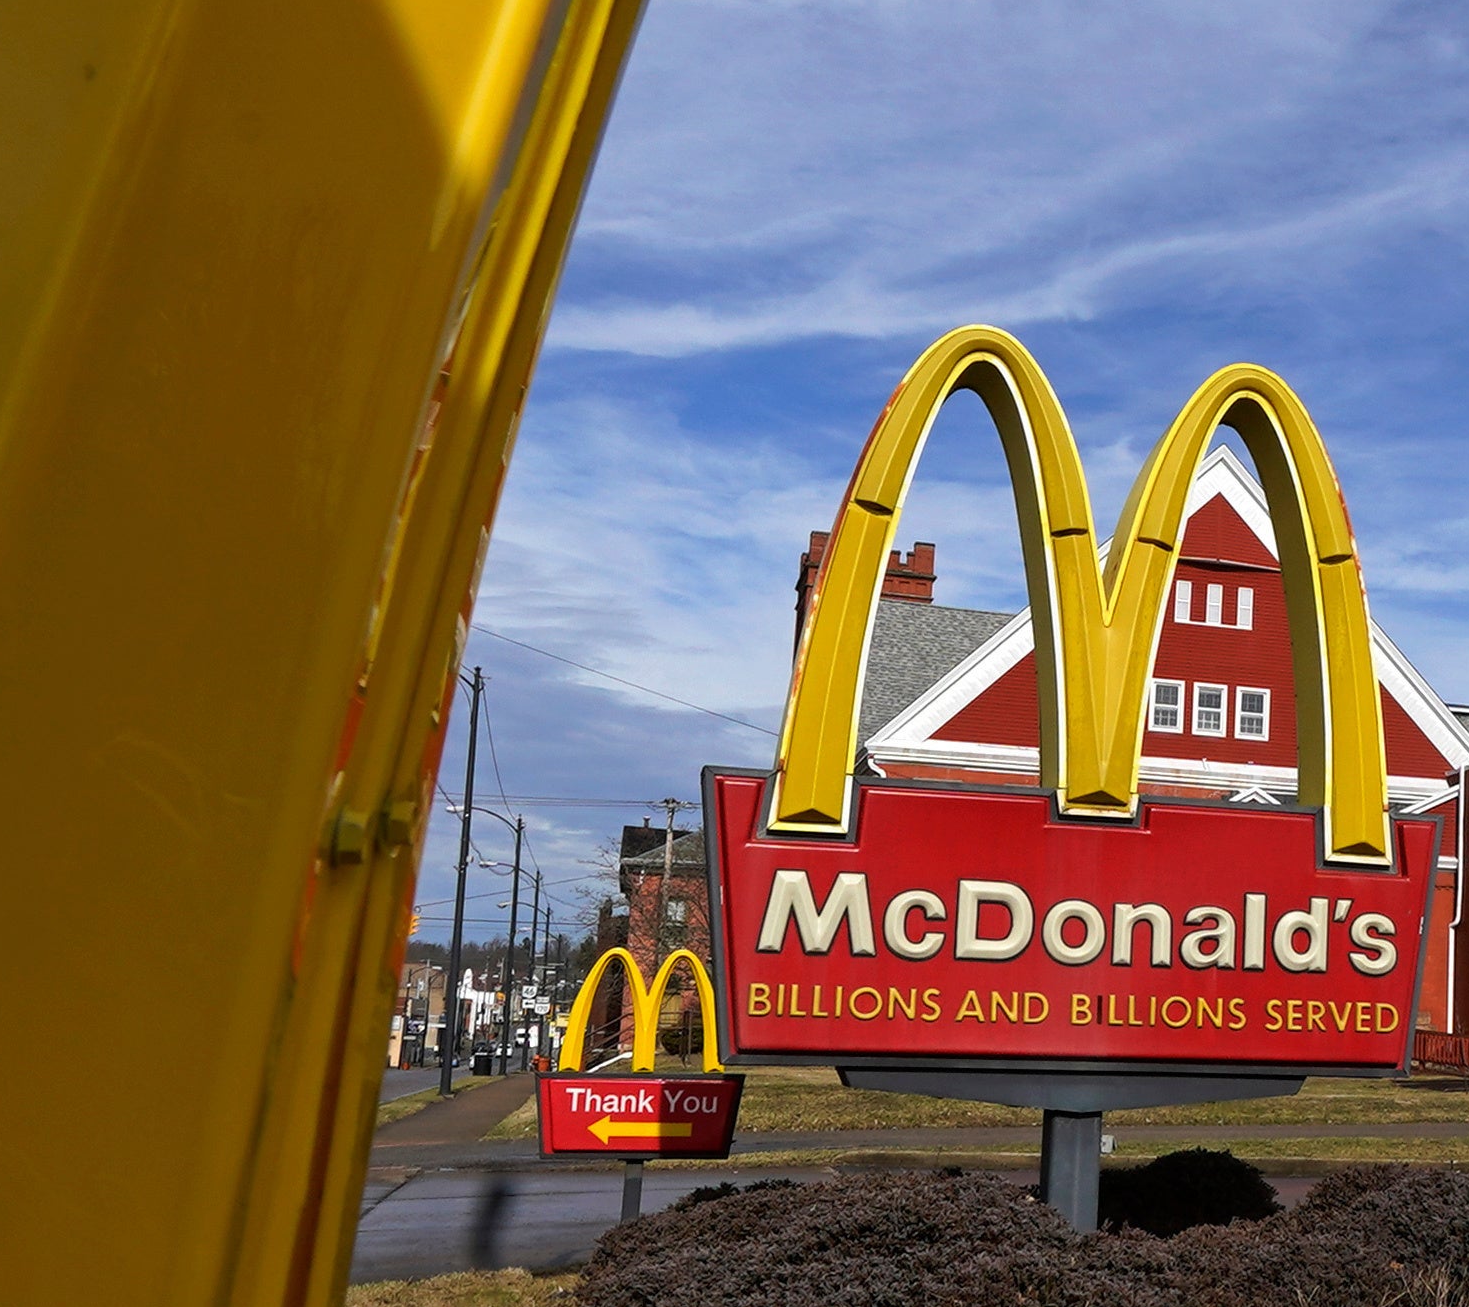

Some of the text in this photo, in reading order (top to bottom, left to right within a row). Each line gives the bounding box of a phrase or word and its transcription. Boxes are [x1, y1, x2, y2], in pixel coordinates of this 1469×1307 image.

[756, 868, 1398, 976] McDonald's
[747, 981, 941, 1024] BILLIONS
[955, 988, 1050, 1026] AND
[1264, 997, 1400, 1034] SERVED
[565, 1087, 718, 1114] Thank You
